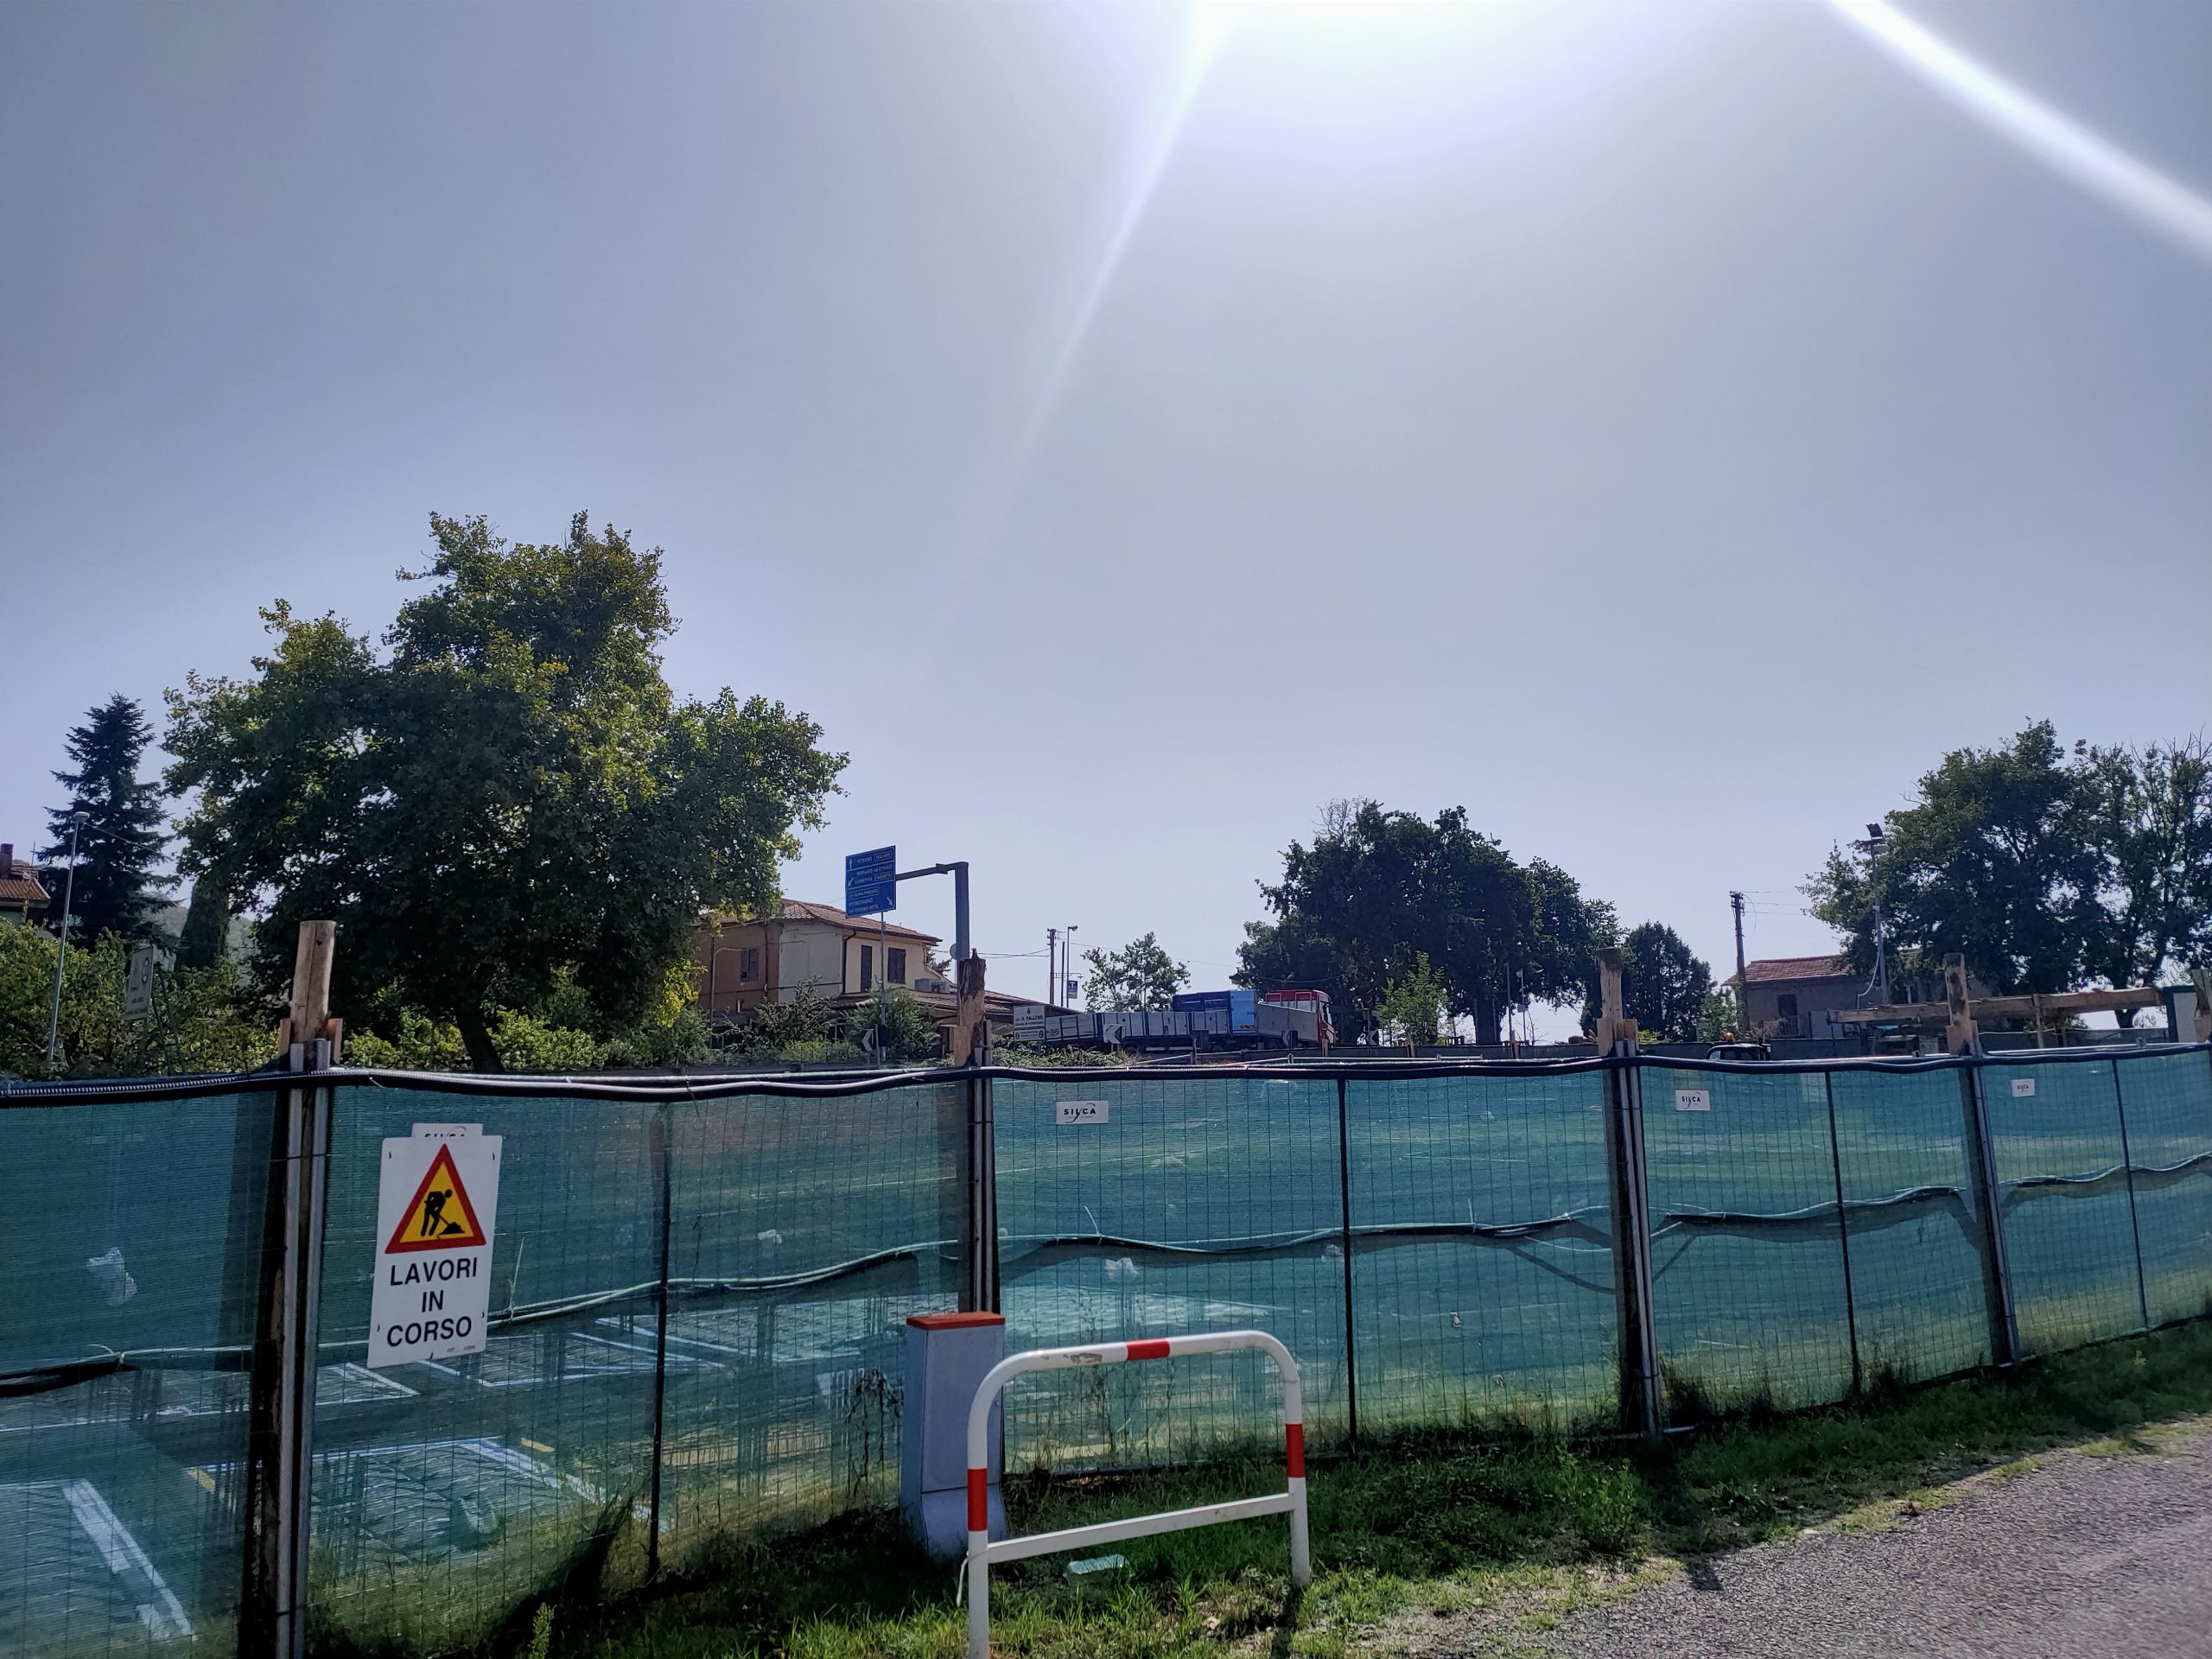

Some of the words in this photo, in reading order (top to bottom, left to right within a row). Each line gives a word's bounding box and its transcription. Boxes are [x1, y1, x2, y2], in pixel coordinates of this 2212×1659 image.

[390, 1256, 478, 1286] LAVORI
[422, 1290, 444, 1313] IN
[387, 1316, 473, 1347] CORSO
